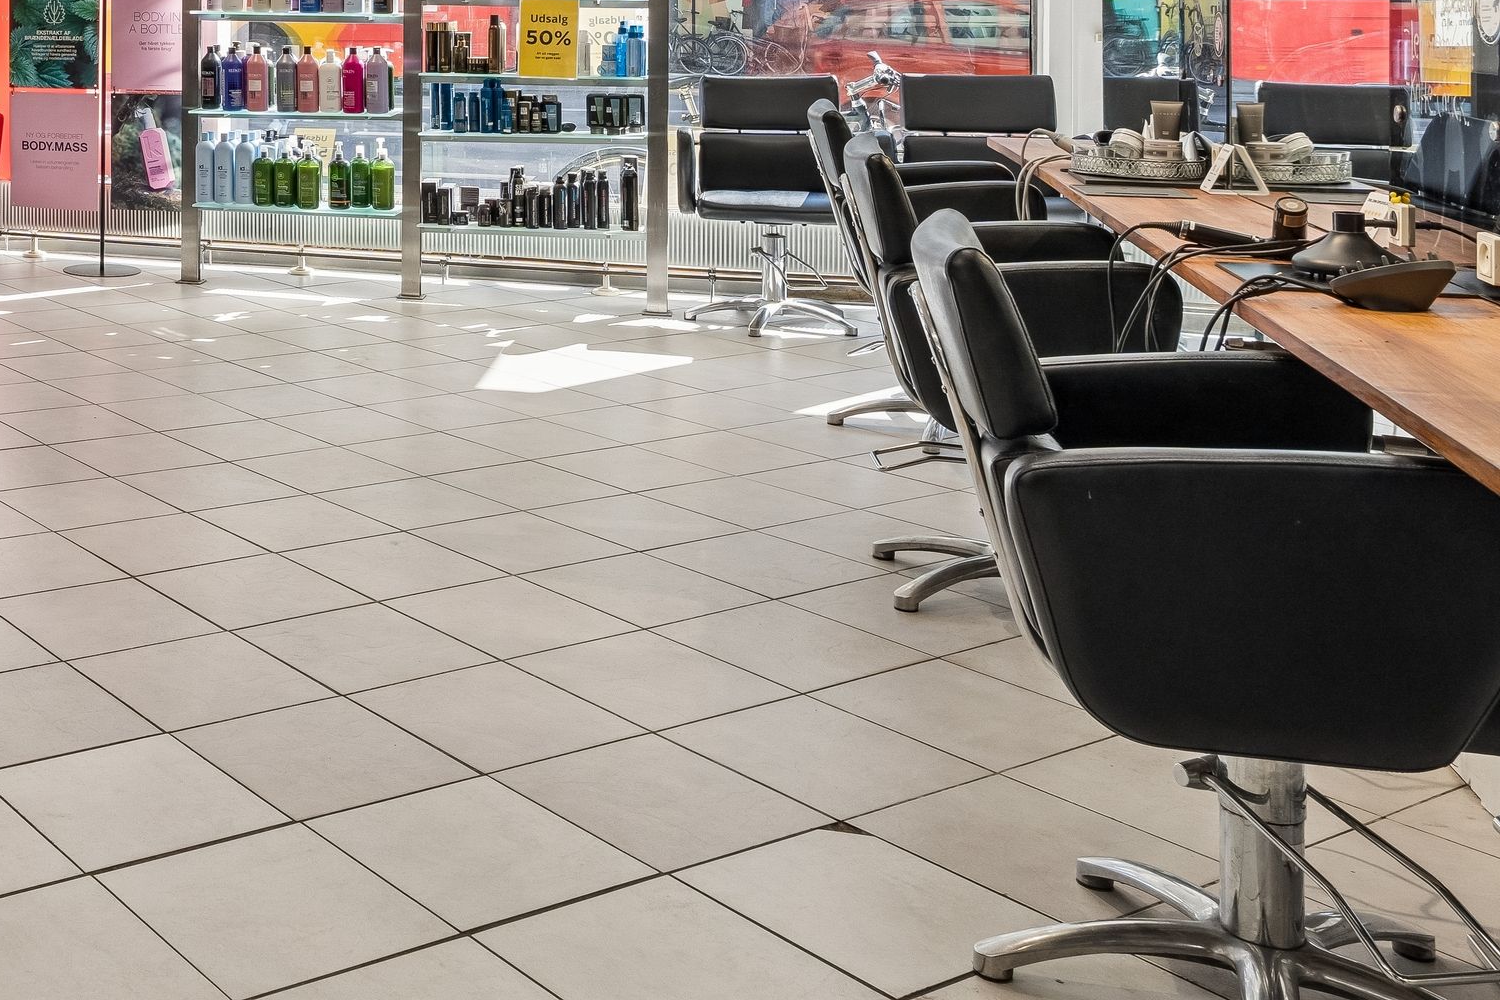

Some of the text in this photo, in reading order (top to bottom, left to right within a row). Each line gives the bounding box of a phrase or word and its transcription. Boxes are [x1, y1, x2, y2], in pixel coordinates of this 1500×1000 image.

[134, 11, 165, 22] BODY
[530, 13, 569, 26] Udsalg
[129, 24, 137, 34] A
[526, 29, 571, 46] 50%
[22, 140, 88, 152] BODY.MASS
